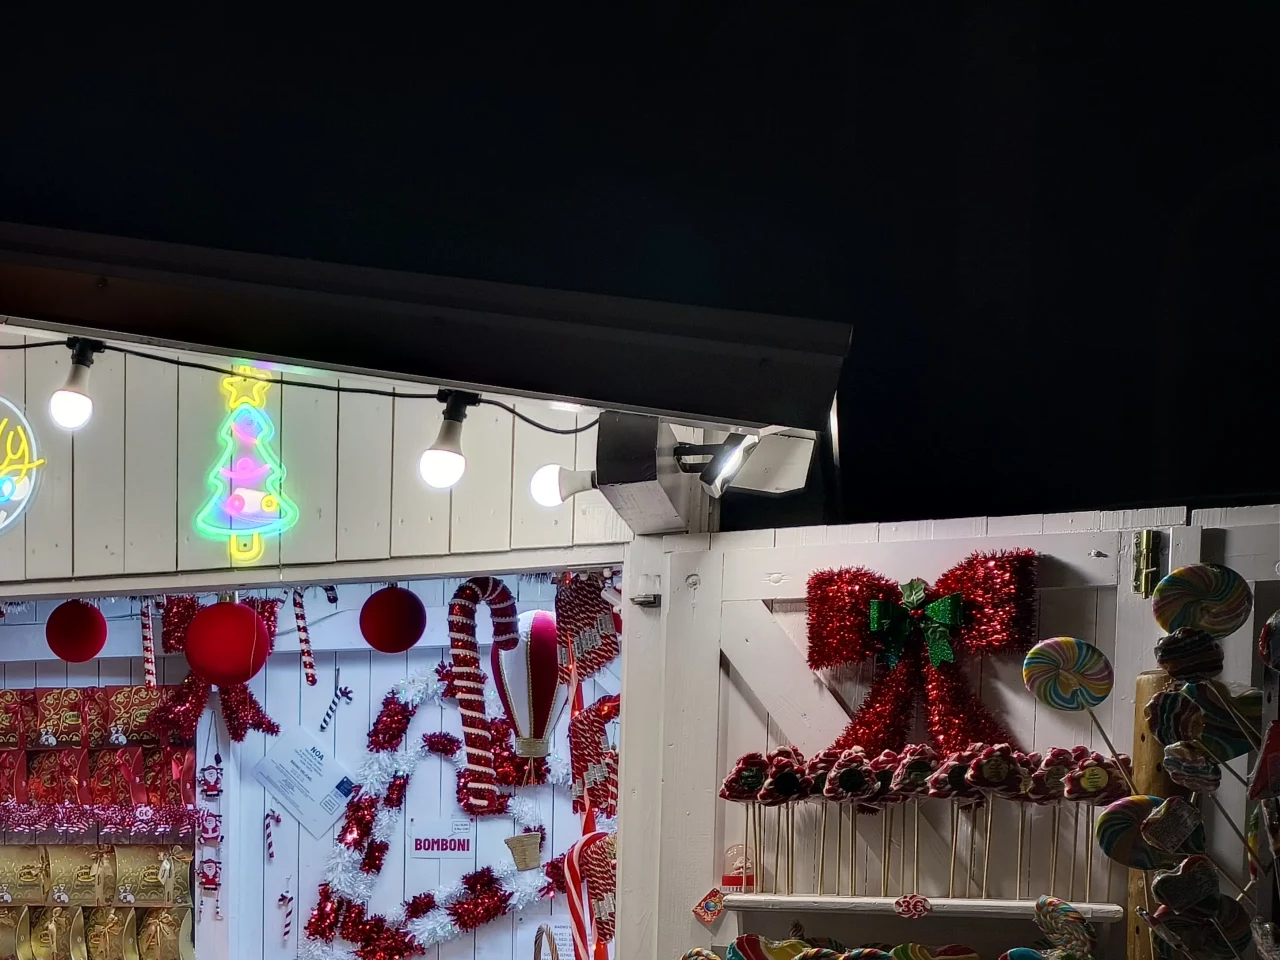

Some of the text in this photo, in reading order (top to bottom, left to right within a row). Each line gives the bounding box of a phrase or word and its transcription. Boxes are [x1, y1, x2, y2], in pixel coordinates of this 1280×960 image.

[310, 746, 325, 761] NOA
[414, 838, 470, 851] BOMBONI
[901, 899, 924, 913] 3€
